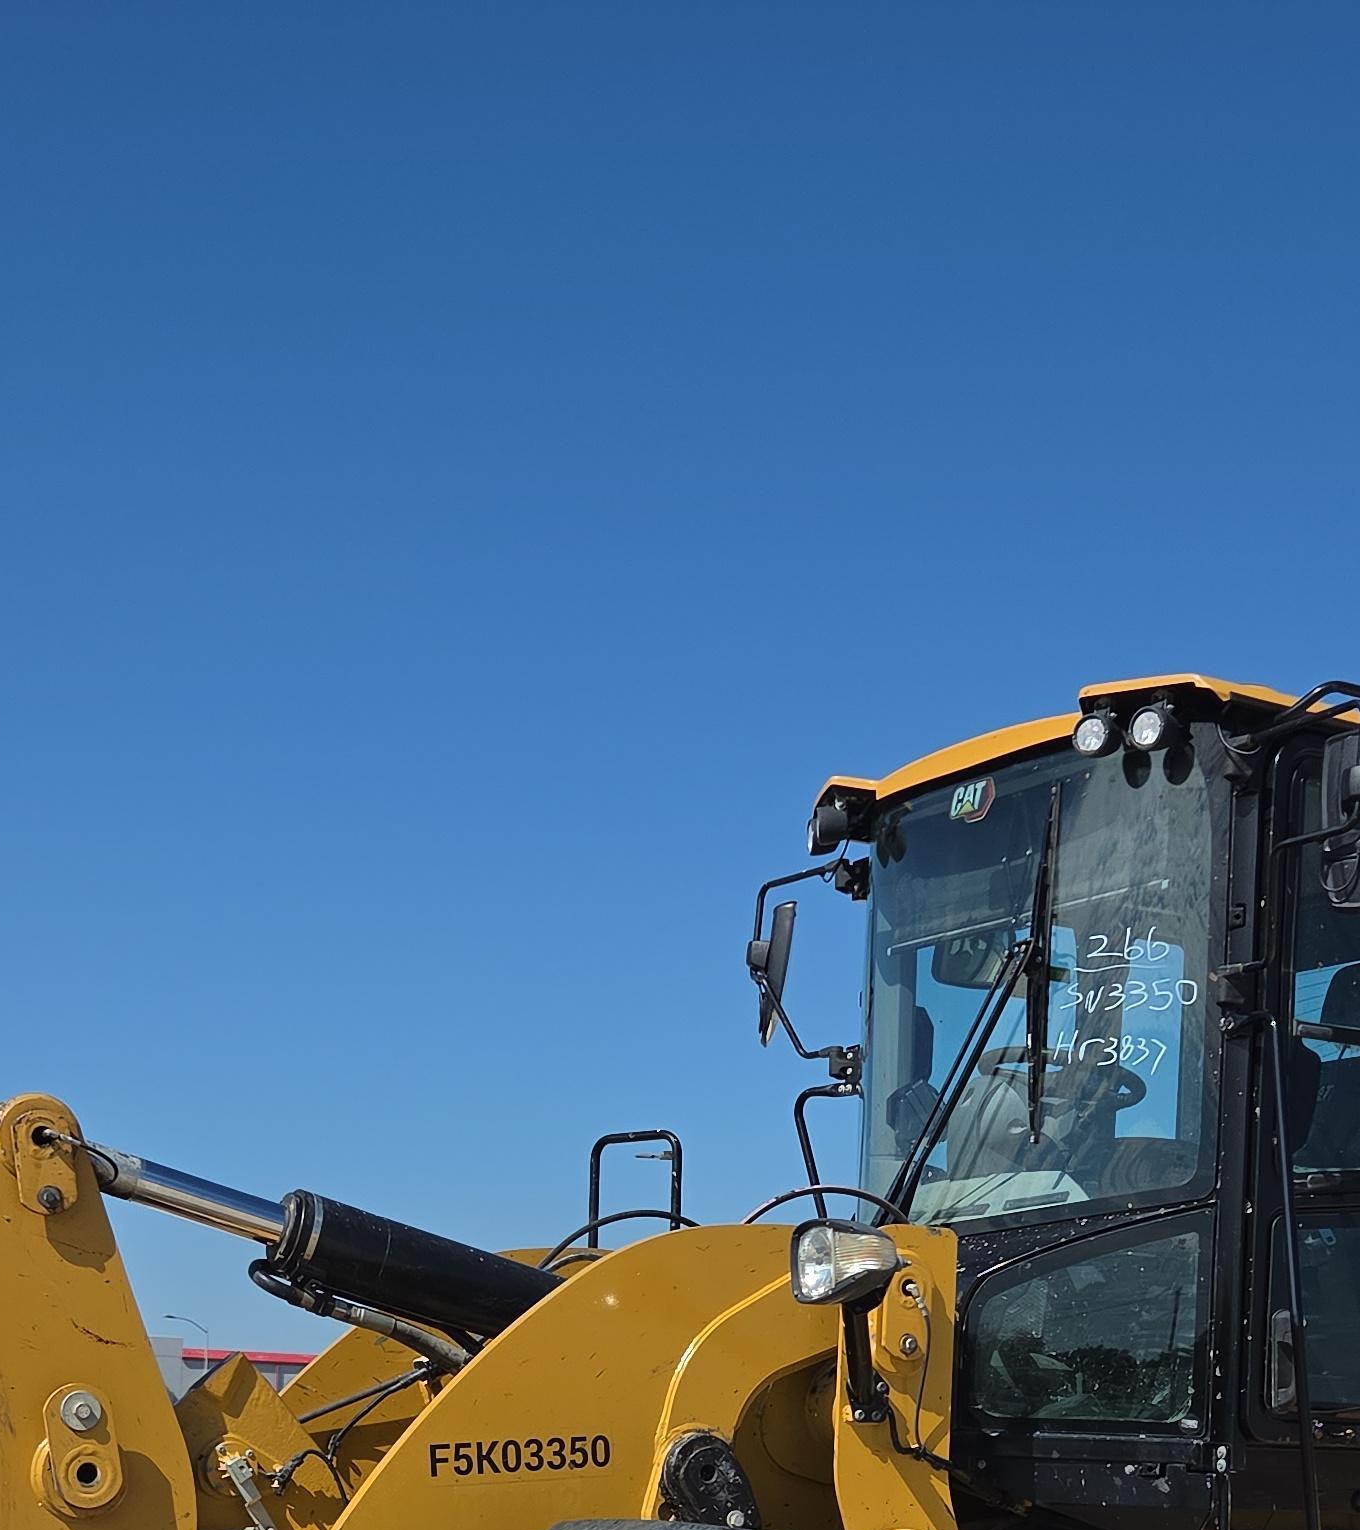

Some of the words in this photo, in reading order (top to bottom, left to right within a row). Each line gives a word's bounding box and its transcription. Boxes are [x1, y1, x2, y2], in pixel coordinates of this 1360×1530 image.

[950, 780, 987, 817] CAT
[1086, 926, 1170, 961] 266
[429, 1434, 611, 1478] F5K03350
